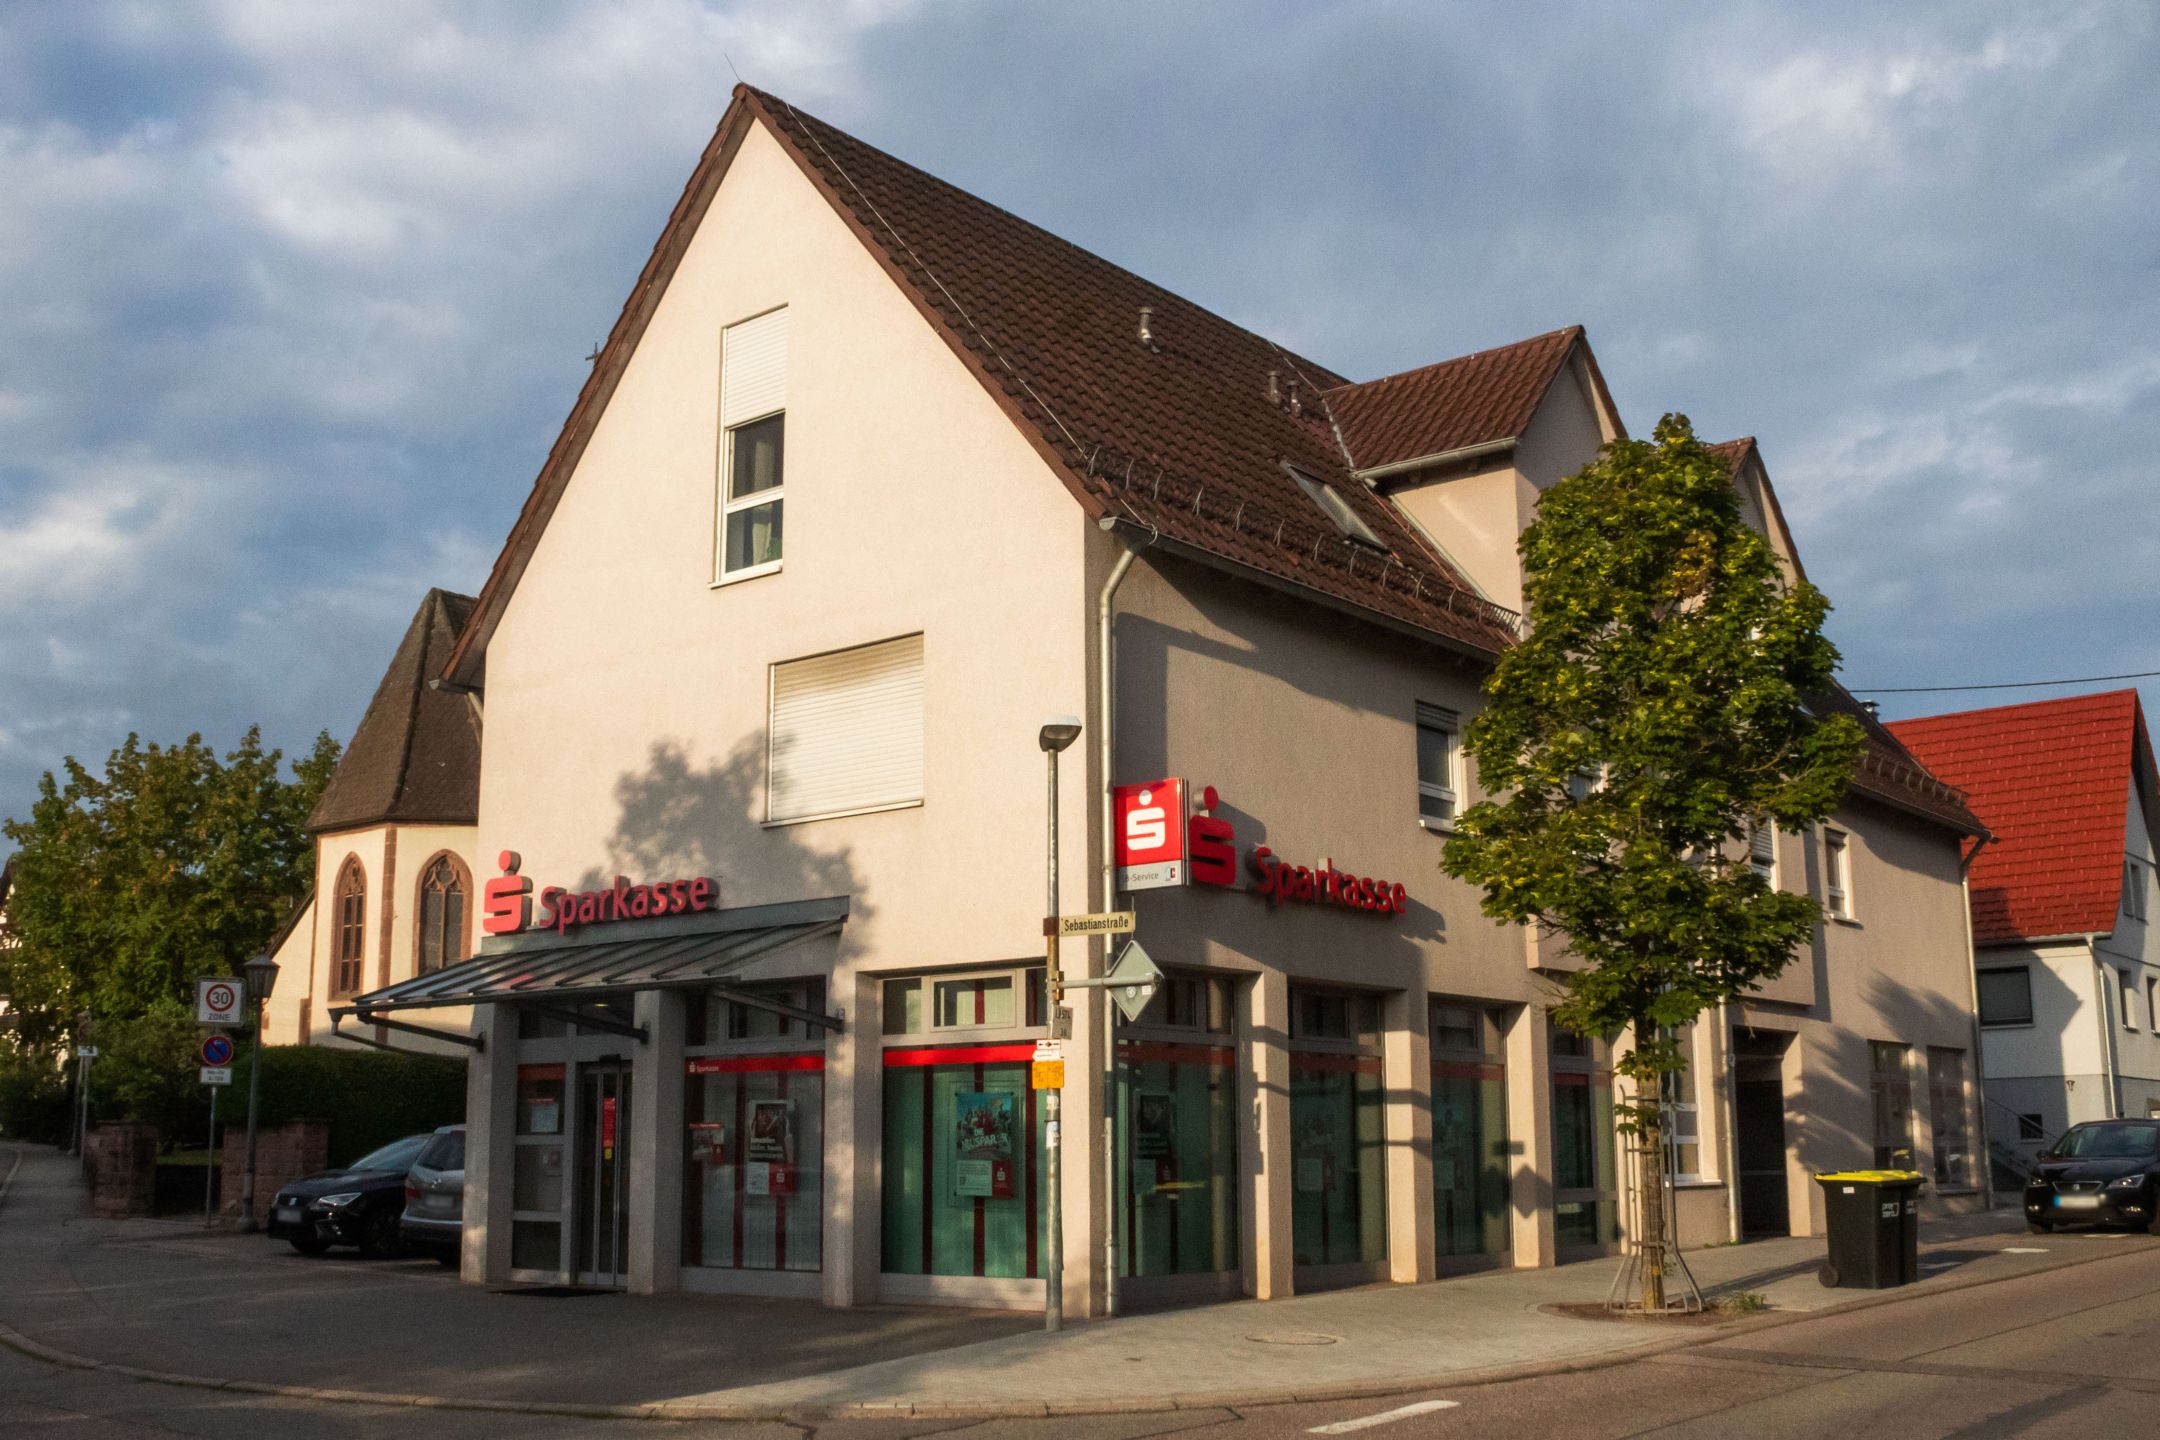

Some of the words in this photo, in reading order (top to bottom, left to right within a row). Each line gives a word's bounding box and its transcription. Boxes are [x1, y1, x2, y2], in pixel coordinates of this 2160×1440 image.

[1256, 847, 1406, 913] Sparkasse
[539, 875, 713, 935] Sparkasse
[1064, 916, 1129, 932] Sebastianstraße
[212, 992, 229, 1004] 30
[208, 1013, 231, 1021] ZONE
